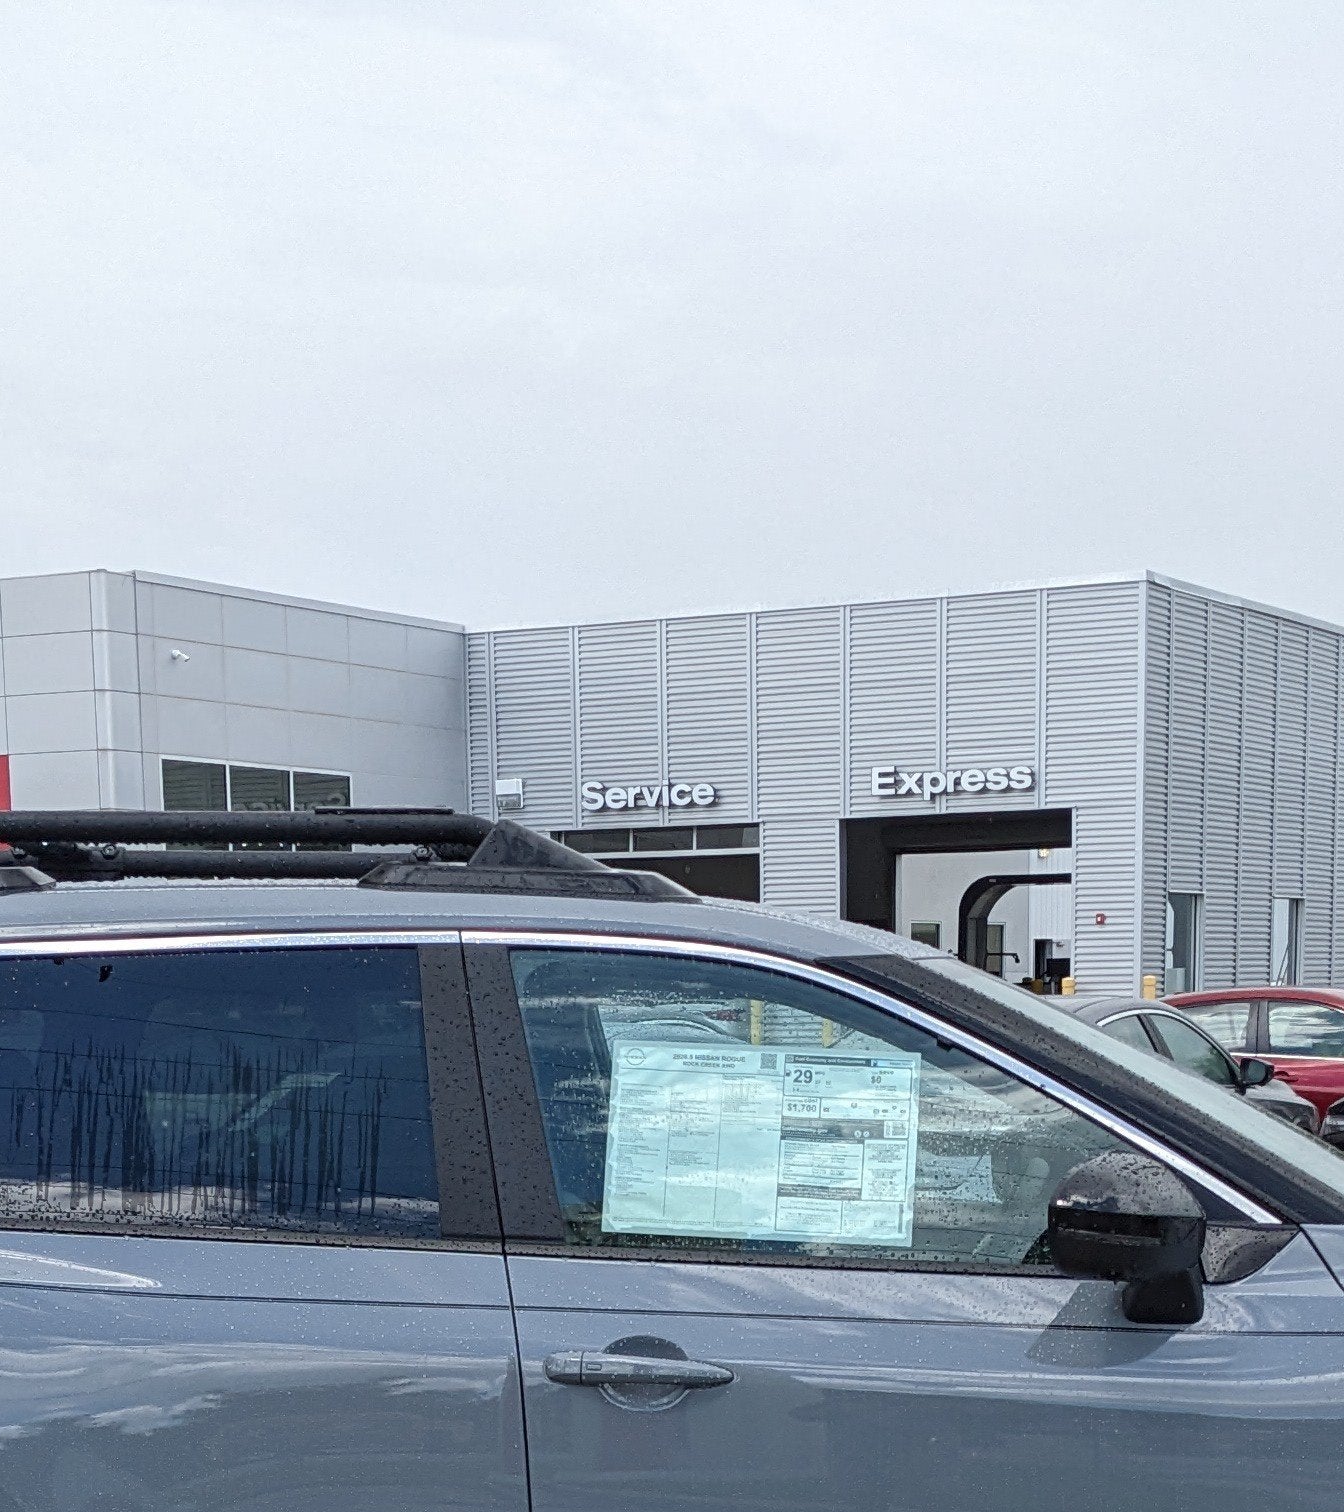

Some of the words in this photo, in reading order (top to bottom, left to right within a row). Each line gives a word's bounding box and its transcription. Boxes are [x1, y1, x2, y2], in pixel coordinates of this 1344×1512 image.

[581, 779, 715, 811] Service
[871, 765, 1033, 801] Express
[792, 1069, 813, 1084] 29
